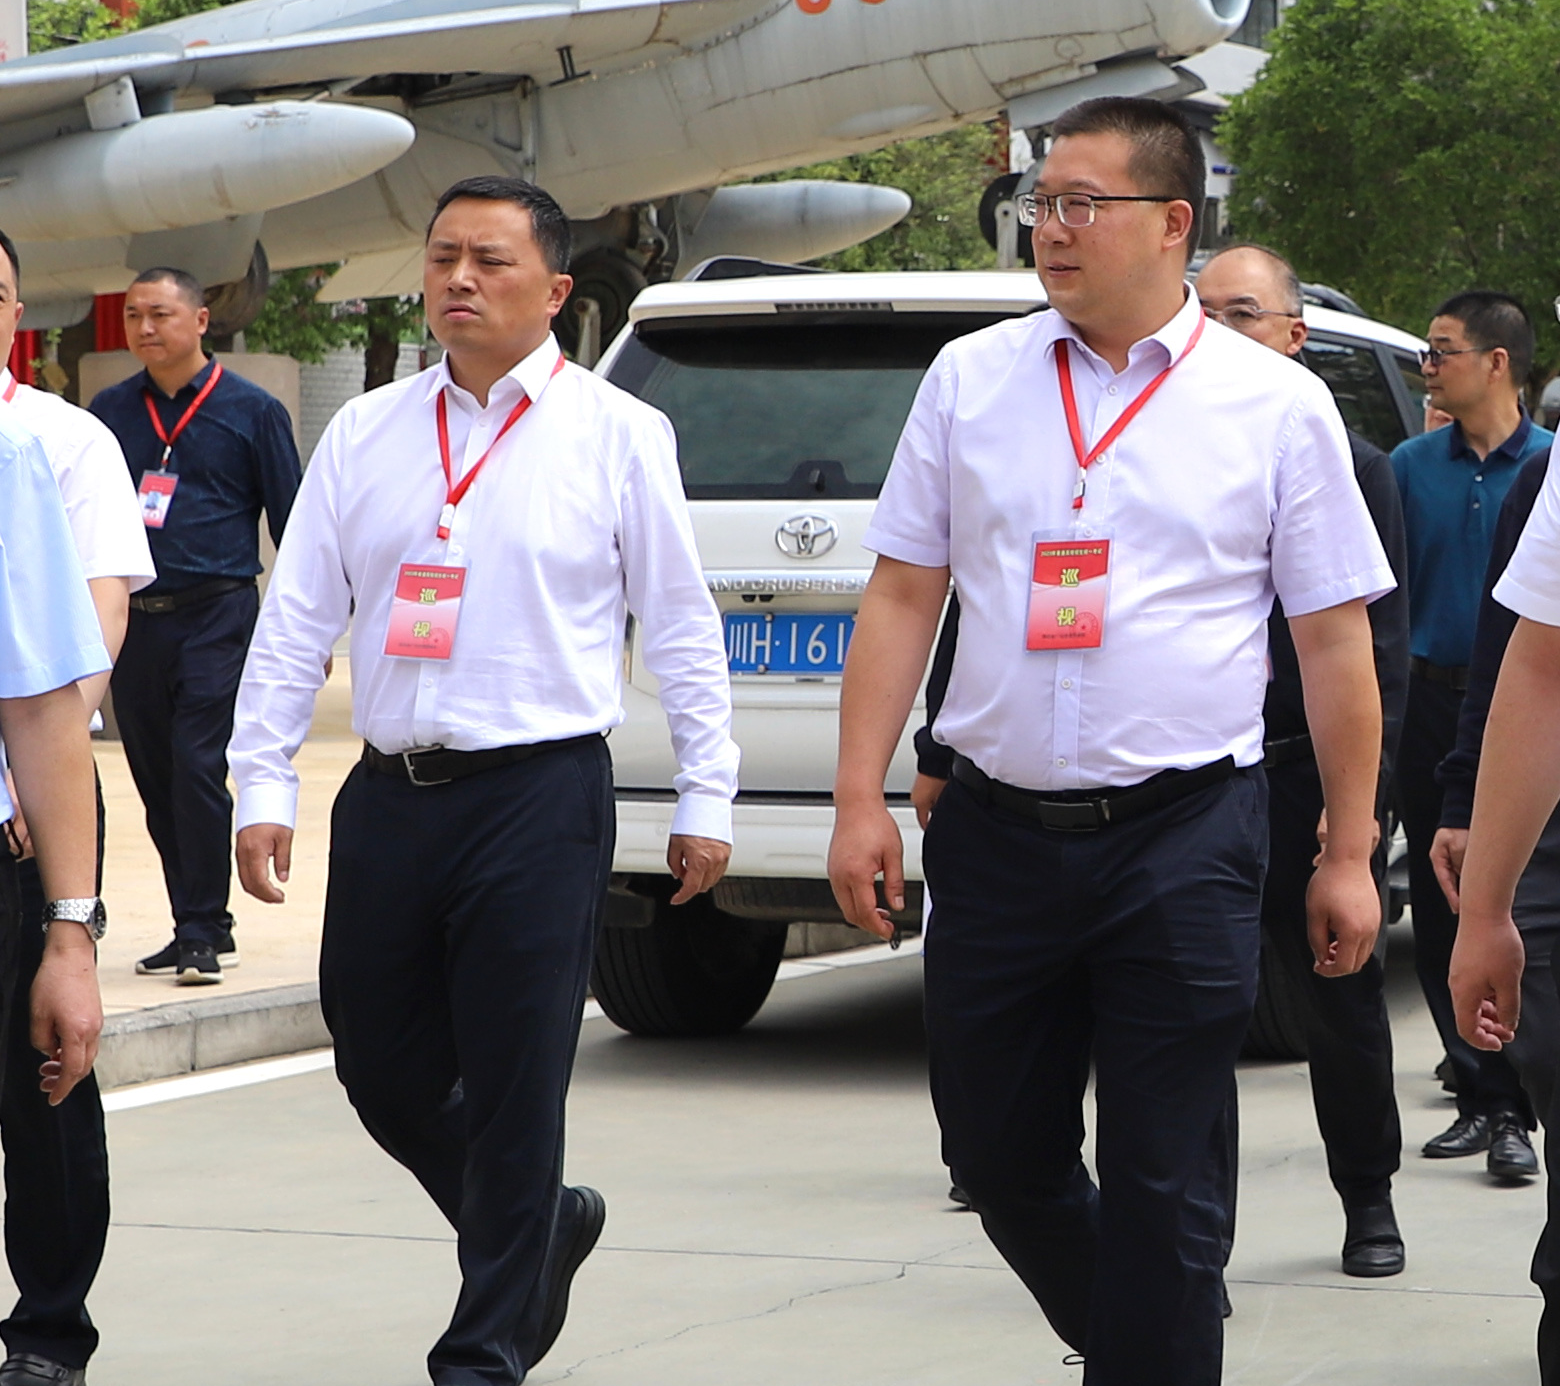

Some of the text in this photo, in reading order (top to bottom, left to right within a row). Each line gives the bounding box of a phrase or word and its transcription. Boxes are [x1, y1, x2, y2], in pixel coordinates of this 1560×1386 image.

[710, 577, 745, 592] AND
[751, 577, 837, 592] CRUISER
[1056, 567, 1080, 627] 巡视
[413, 587, 438, 639] 巡视
[727, 621, 846, 666] 川H·161
